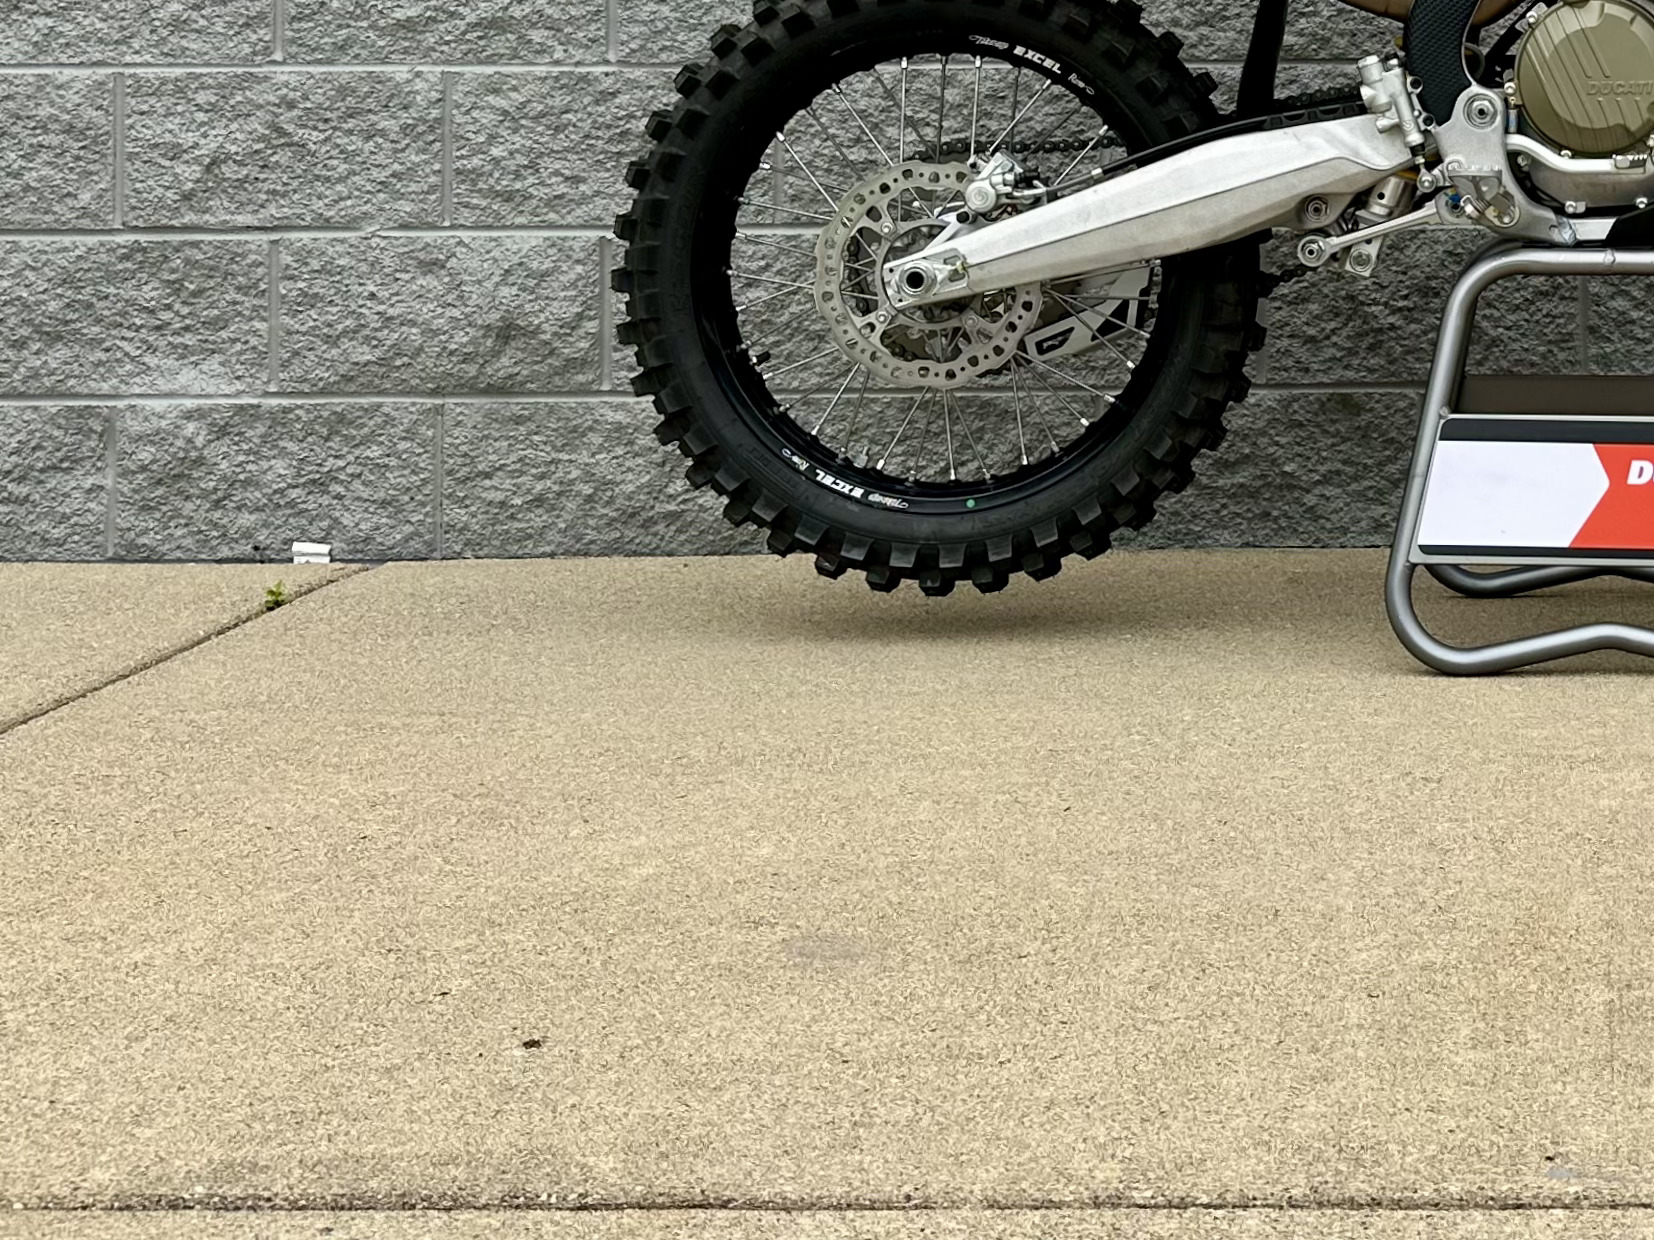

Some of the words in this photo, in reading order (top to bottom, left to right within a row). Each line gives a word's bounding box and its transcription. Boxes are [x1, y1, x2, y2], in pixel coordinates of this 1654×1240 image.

[1012, 44, 1062, 75] EXCEL
[1586, 80, 1654, 96] DUCATI
[815, 469, 864, 498] EXCEL
